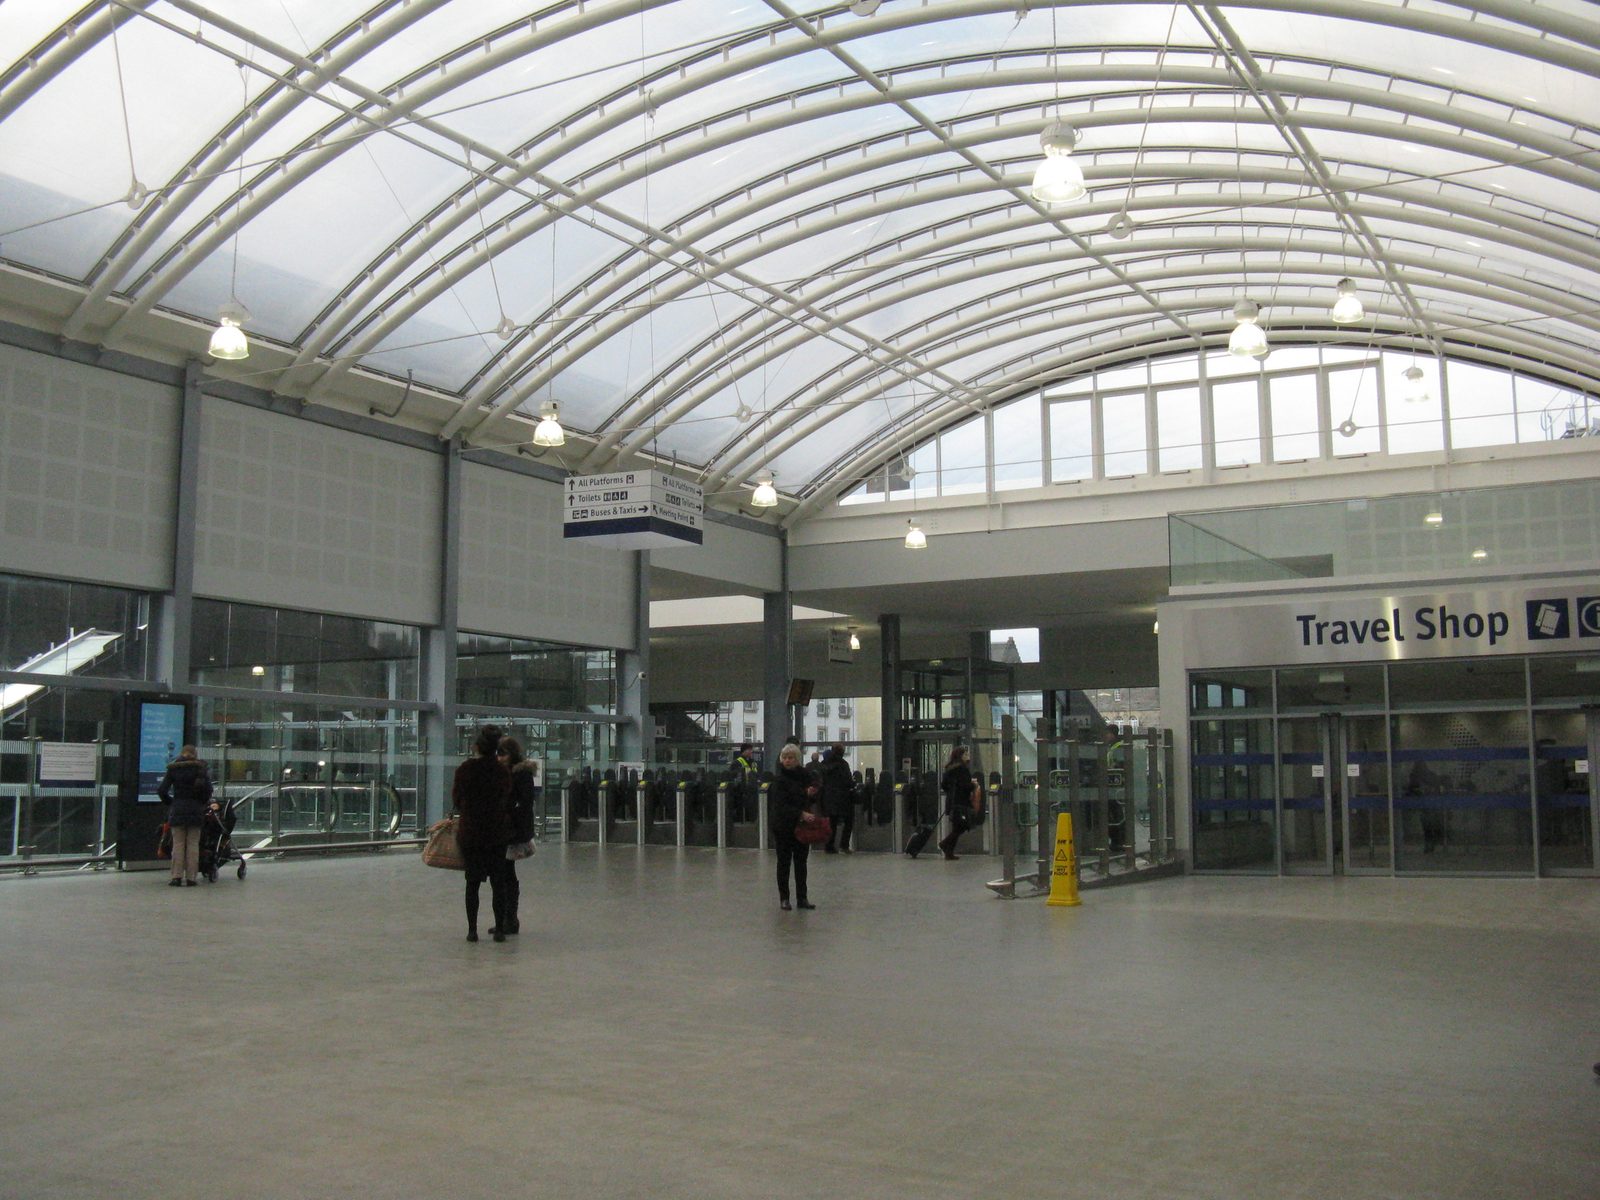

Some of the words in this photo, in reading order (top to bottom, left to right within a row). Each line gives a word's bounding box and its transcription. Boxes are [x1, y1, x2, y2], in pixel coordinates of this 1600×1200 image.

[578, 479, 588, 487] All
[589, 476, 623, 487] Platforms
[578, 493, 601, 502] Toilets
[590, 509, 611, 517] Buses
[612, 507, 618, 515] &
[619, 505, 637, 514] Taxis
[1296, 608, 1404, 646] Travel
[1415, 605, 1509, 646] Shop
